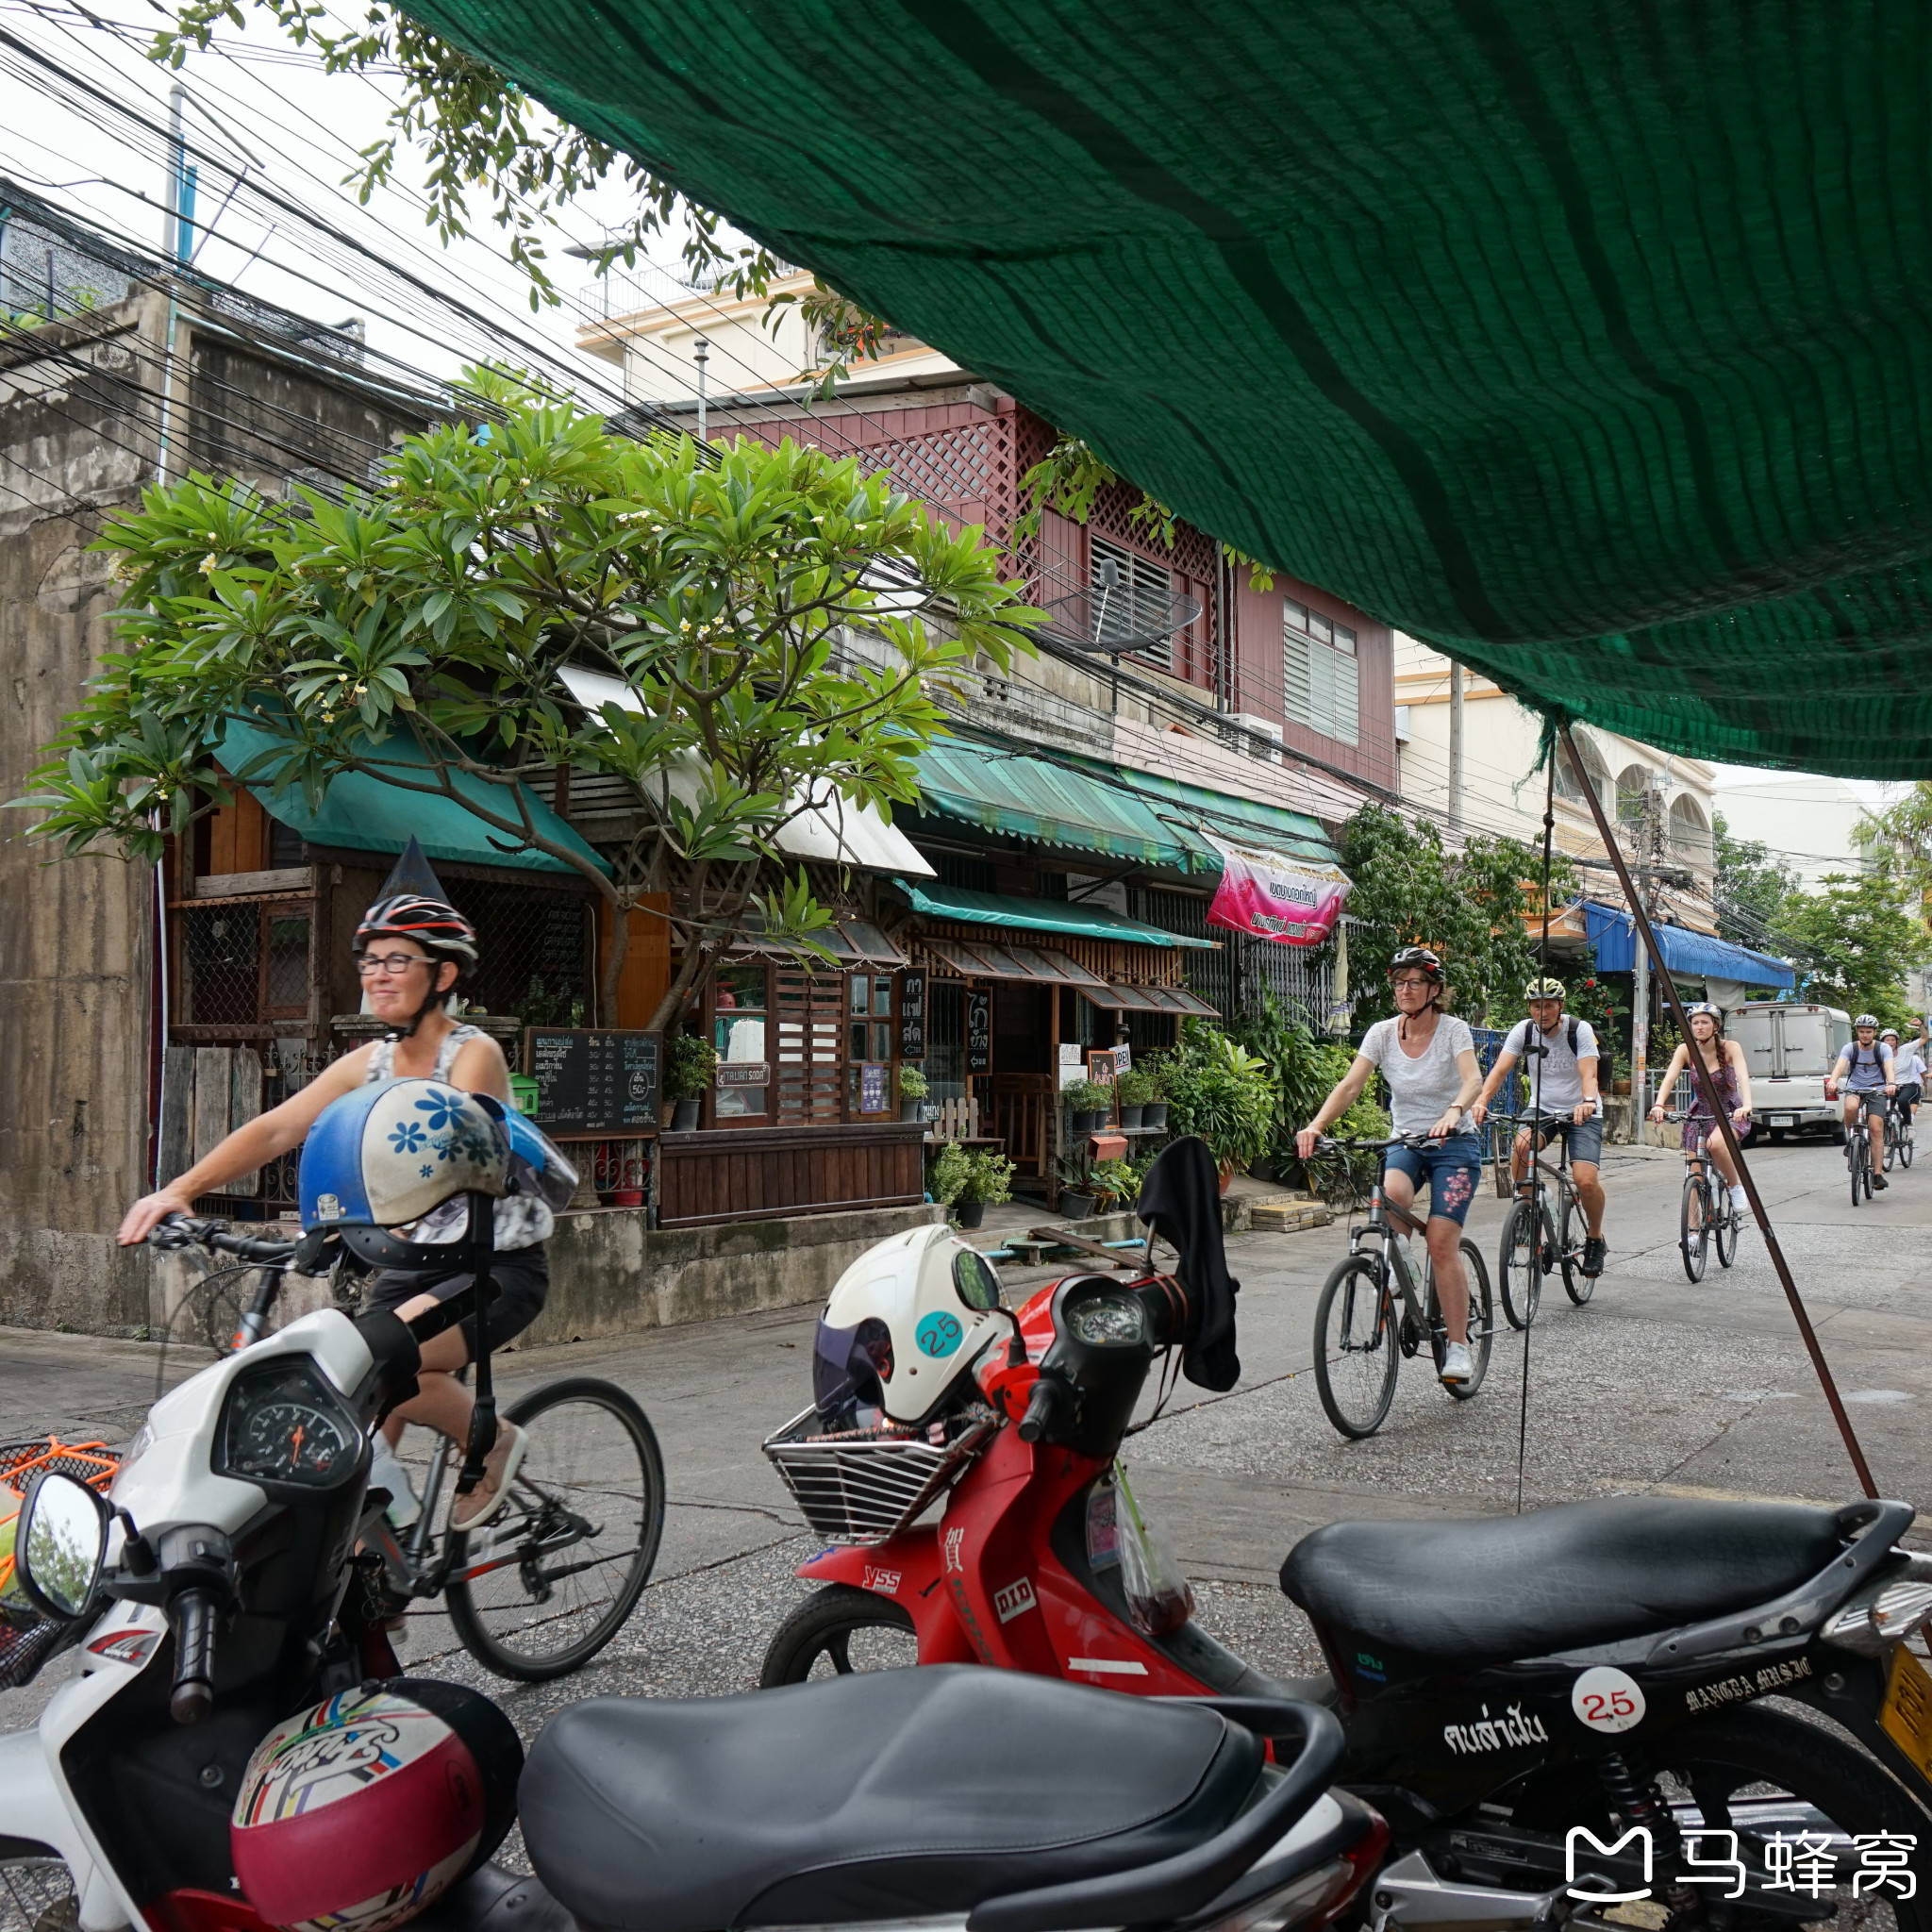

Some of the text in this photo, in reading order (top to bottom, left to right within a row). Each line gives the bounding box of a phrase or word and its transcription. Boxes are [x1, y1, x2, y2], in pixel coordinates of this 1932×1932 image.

[723, 1070, 764, 1081] ITALIAN SODA
[921, 1313, 959, 1357] 25
[1583, 1690, 1636, 1721] 25
[1444, 1700, 1549, 1755] คนล่าฝัน
